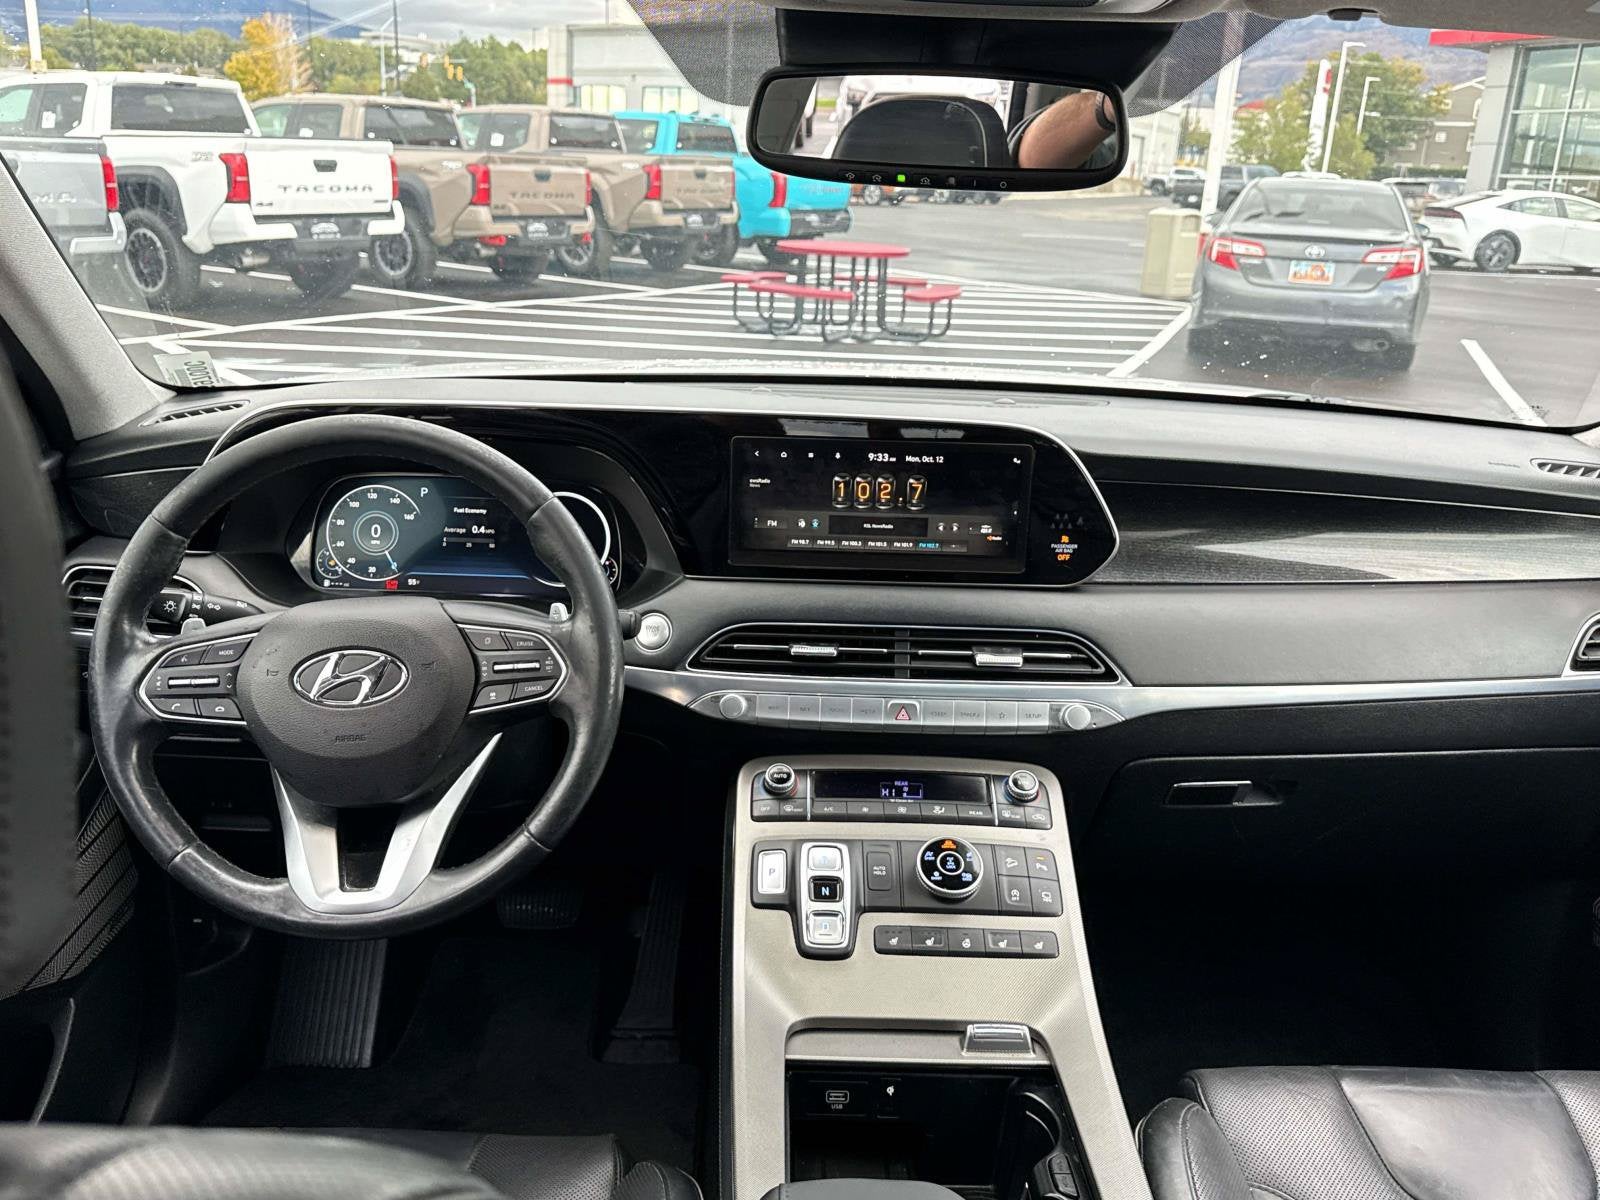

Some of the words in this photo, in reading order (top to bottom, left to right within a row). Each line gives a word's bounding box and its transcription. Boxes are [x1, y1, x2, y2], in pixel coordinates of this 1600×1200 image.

[278, 184, 374, 194] TACOMA
[510, 192, 575, 200] TACOMA
[867, 452, 889, 462] 9:33
[420, 487, 429, 498] P
[370, 524, 381, 538] 0
[443, 526, 467, 534] Average
[471, 525, 486, 534] 0.4
[1057, 553, 1071, 561] OFF
[821, 886, 830, 896] N
